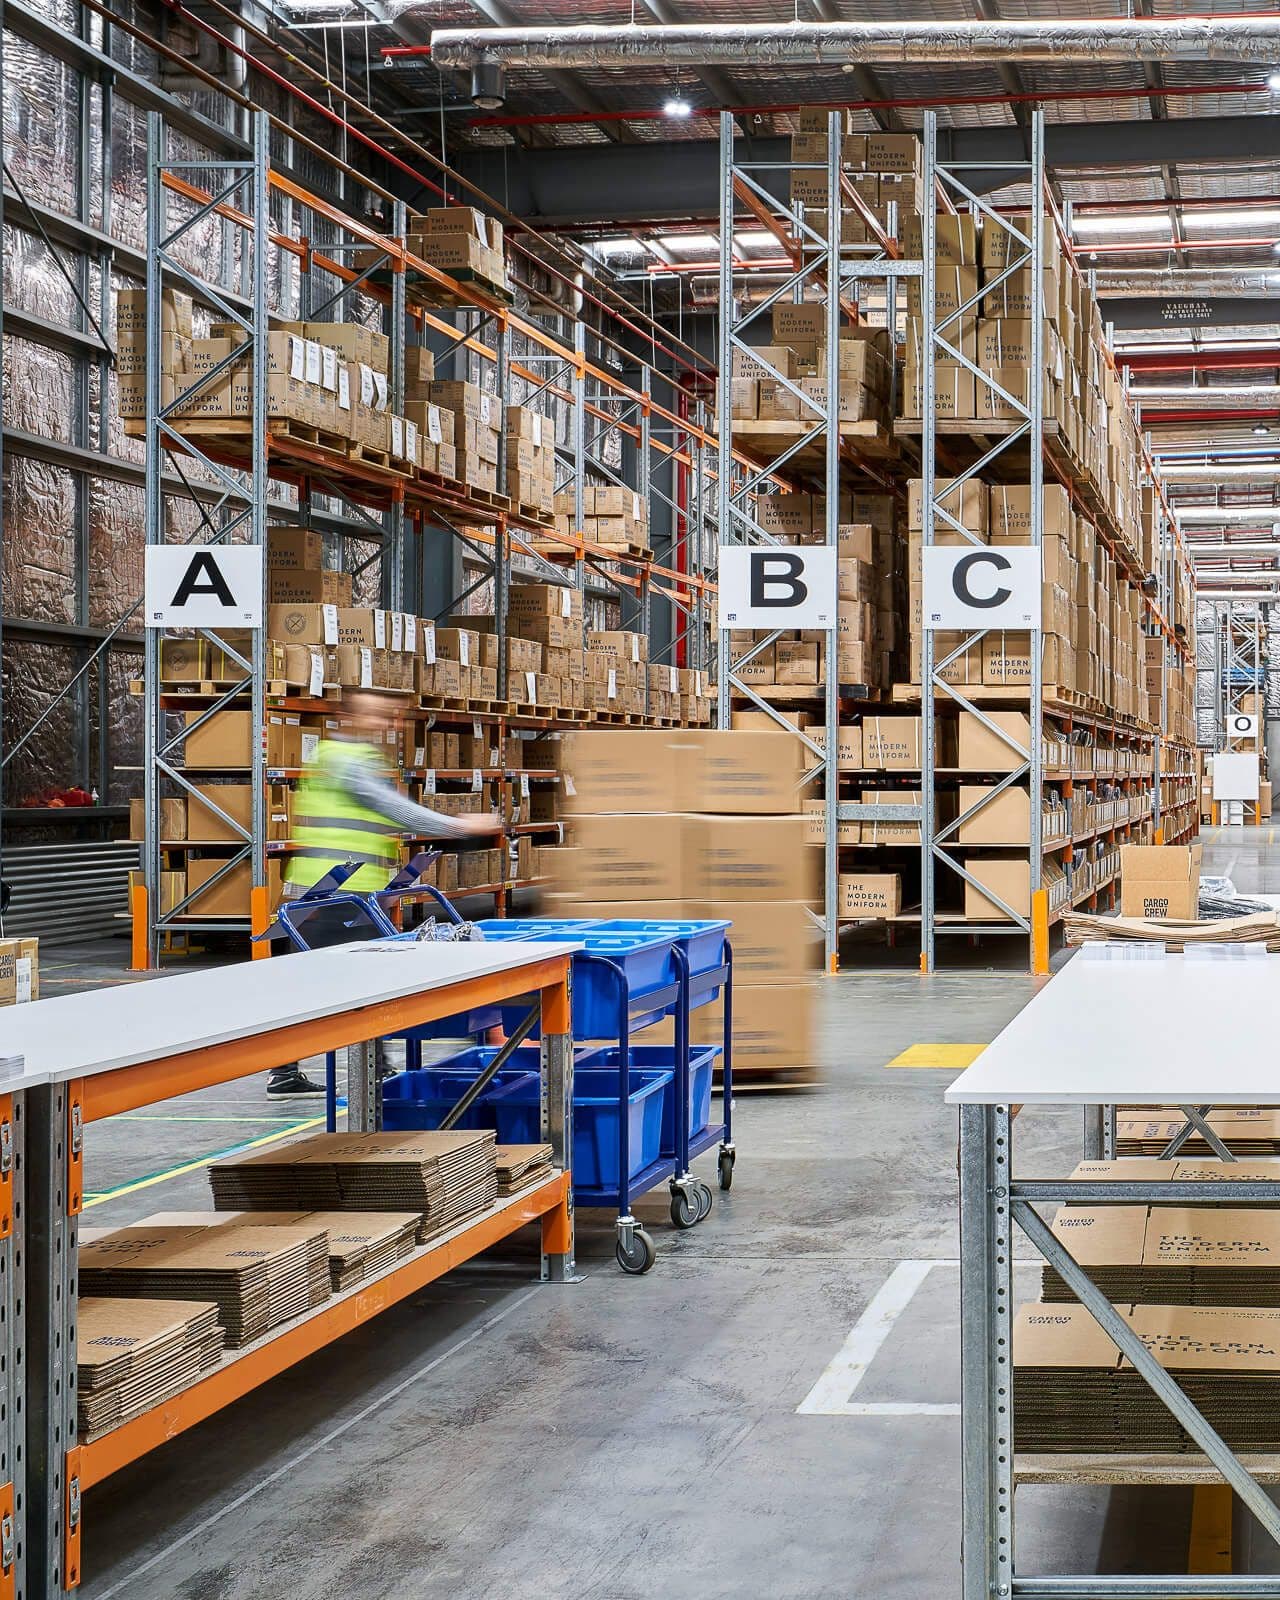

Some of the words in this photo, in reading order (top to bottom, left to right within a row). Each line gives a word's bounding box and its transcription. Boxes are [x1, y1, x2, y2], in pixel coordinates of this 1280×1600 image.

[170, 551, 237, 607] A
[751, 552, 808, 608] B
[952, 552, 1012, 609] C
[1235, 716, 1251, 731] O
[1143, 898, 1169, 908] CARGO
[1144, 908, 1168, 917] CREW
